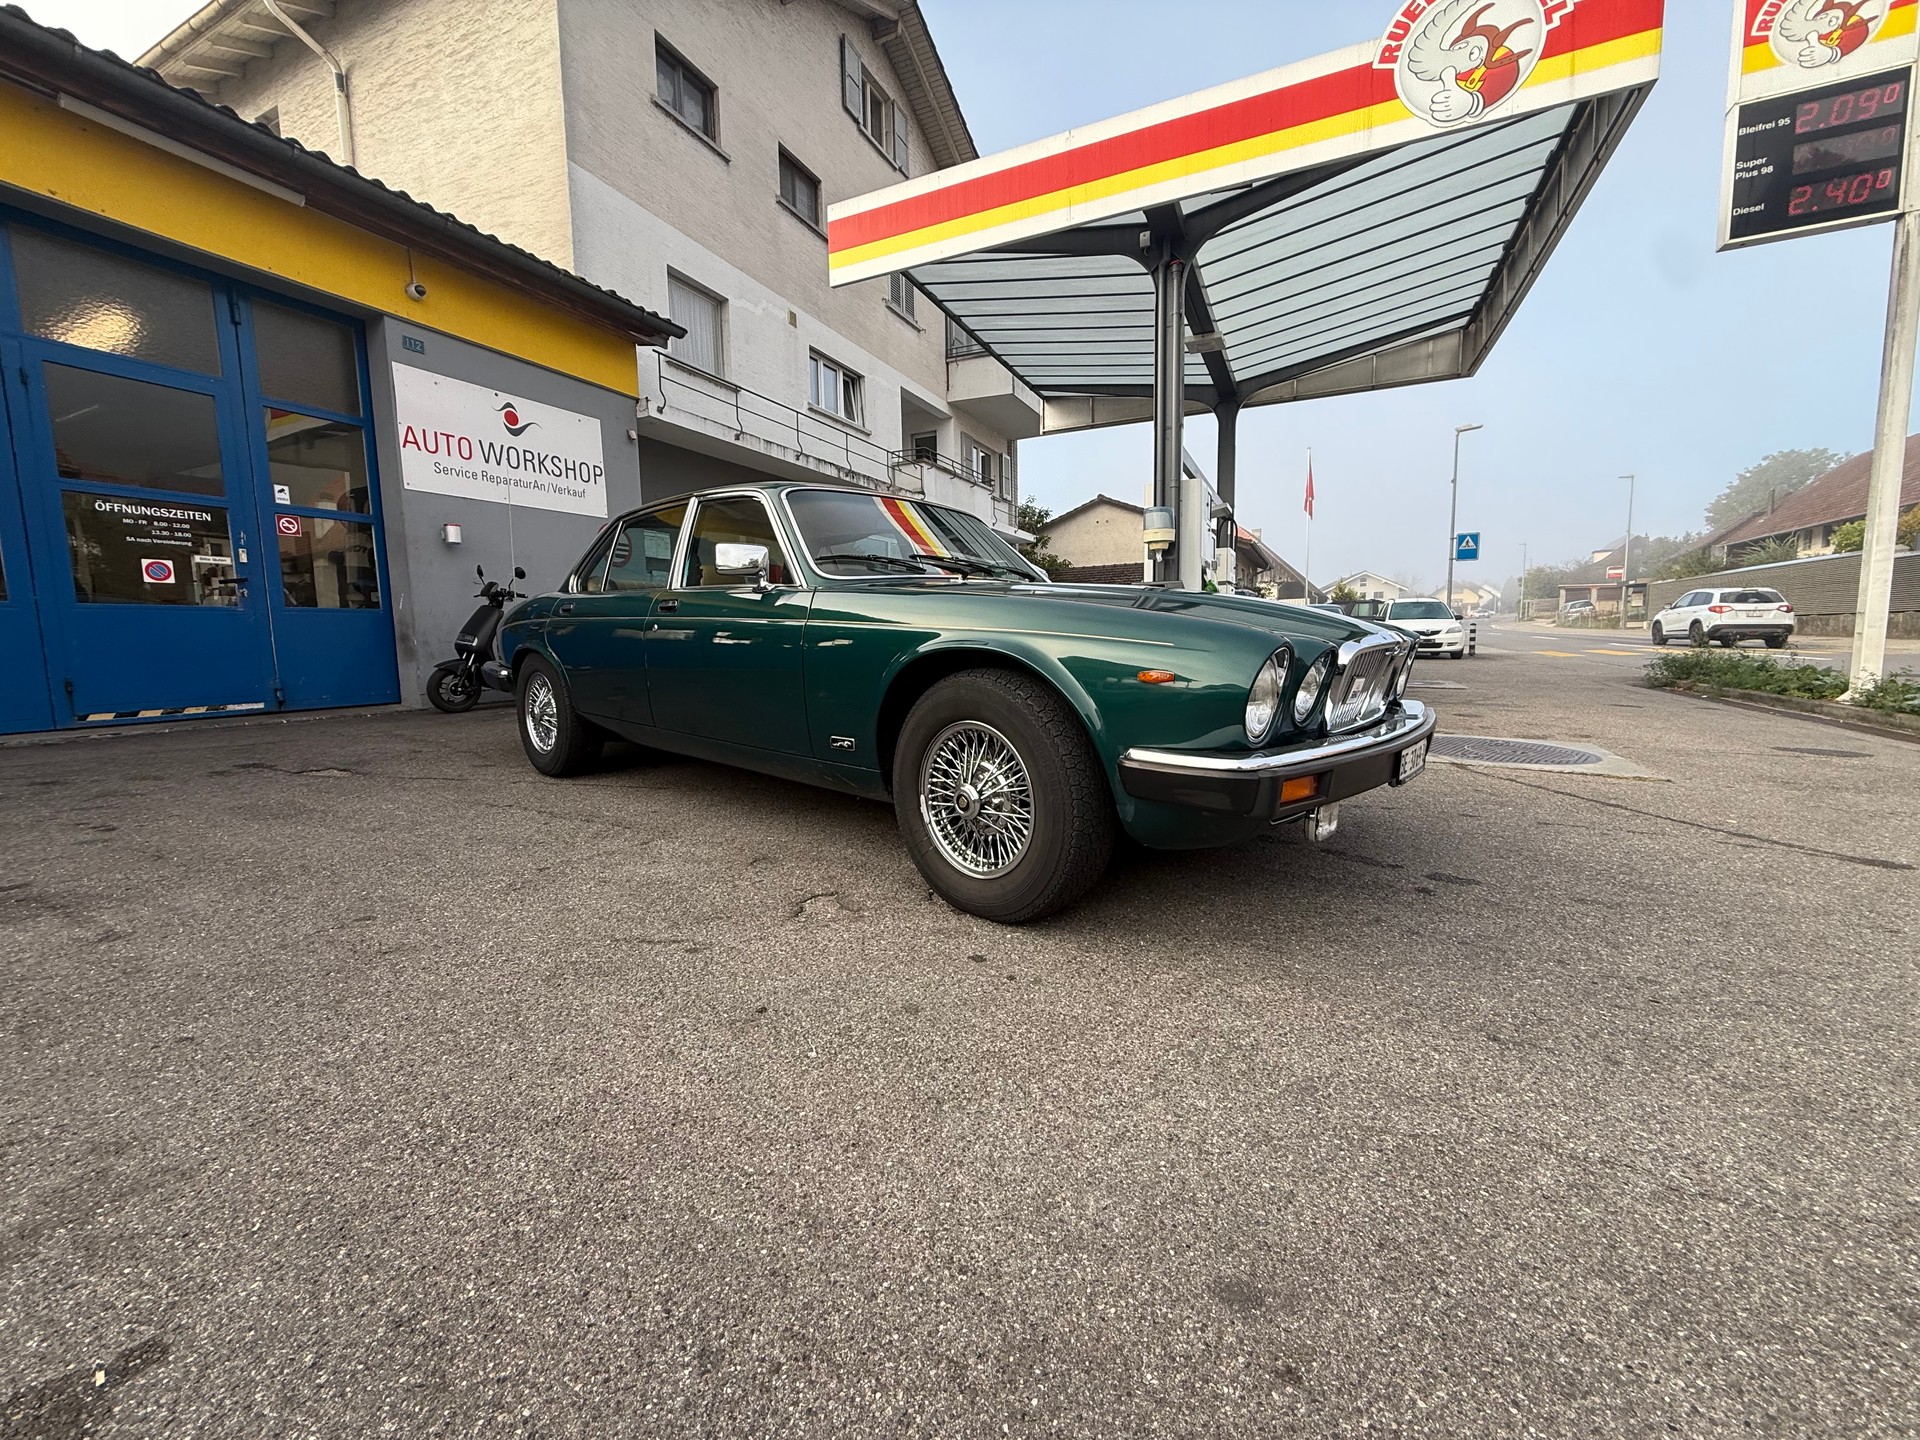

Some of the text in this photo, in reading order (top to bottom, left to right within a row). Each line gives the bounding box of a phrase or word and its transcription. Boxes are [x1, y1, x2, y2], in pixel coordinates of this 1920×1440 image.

[1378, 0, 1437, 64] RUE
[1738, 117, 1791, 136] Bleifrei 95
[1735, 165, 1774, 180] Plus 98
[1736, 157, 1768, 170] Super
[1733, 203, 1765, 216] Diesel
[405, 338, 422, 351] 112
[402, 425, 604, 485] AUTO WORKSHOP
[434, 461, 478, 480] Service
[95, 499, 212, 522] ÖFFNUNGSZEITEN
